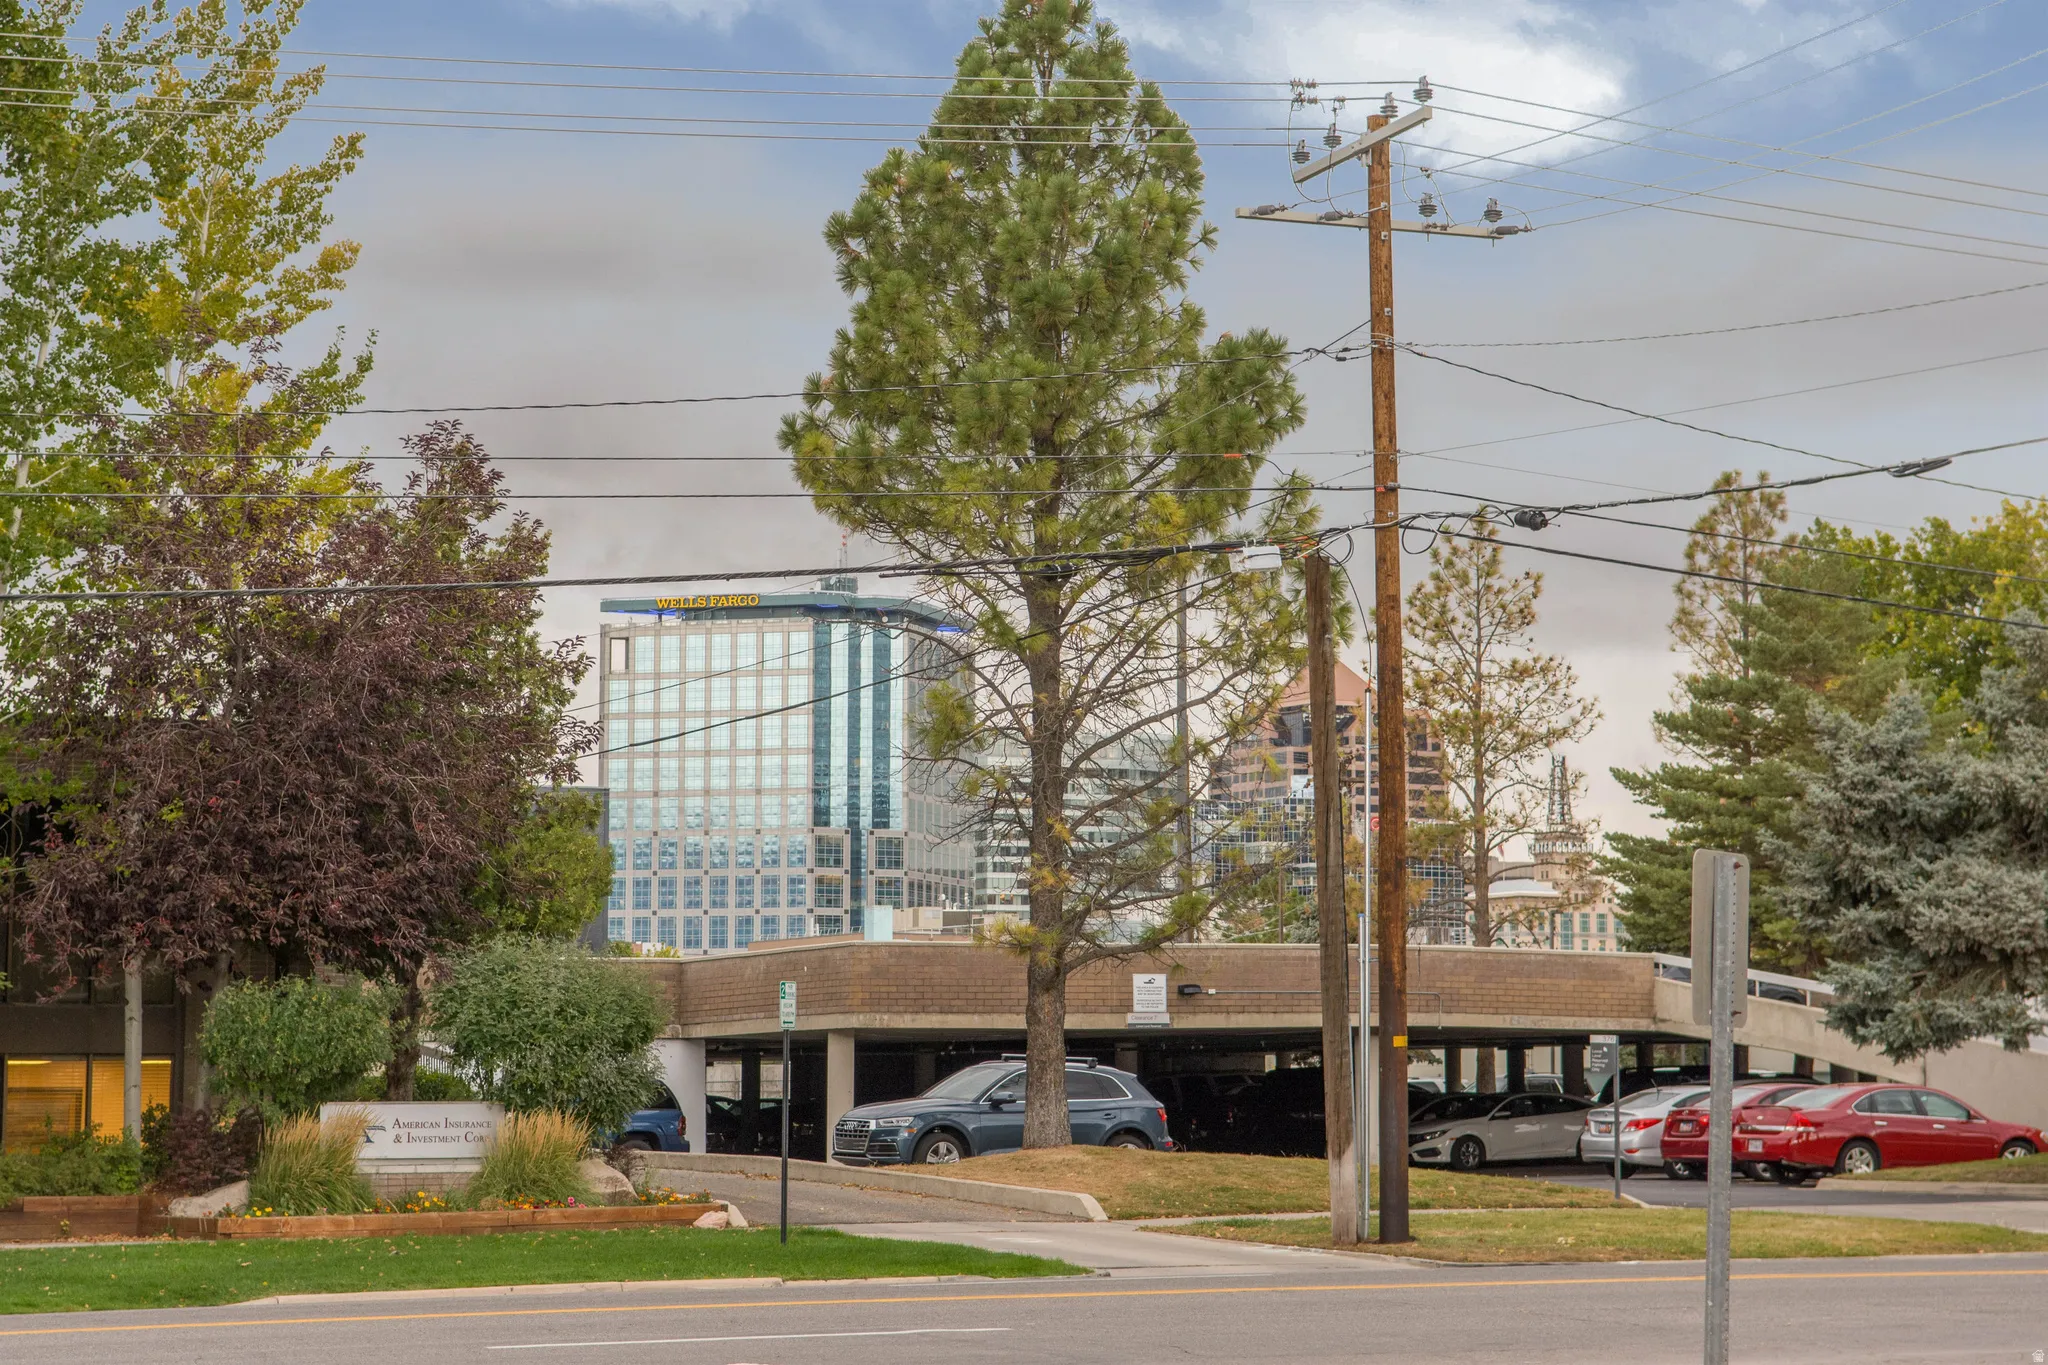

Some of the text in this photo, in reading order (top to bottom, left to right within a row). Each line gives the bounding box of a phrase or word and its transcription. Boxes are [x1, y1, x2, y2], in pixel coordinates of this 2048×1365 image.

[655, 594, 759, 609] WELLS FARGO
[392, 1117, 492, 1129] AMERICAN INSURANCE
[393, 1133, 402, 1144] &
[407, 1132, 461, 1143] INVESTMENT
